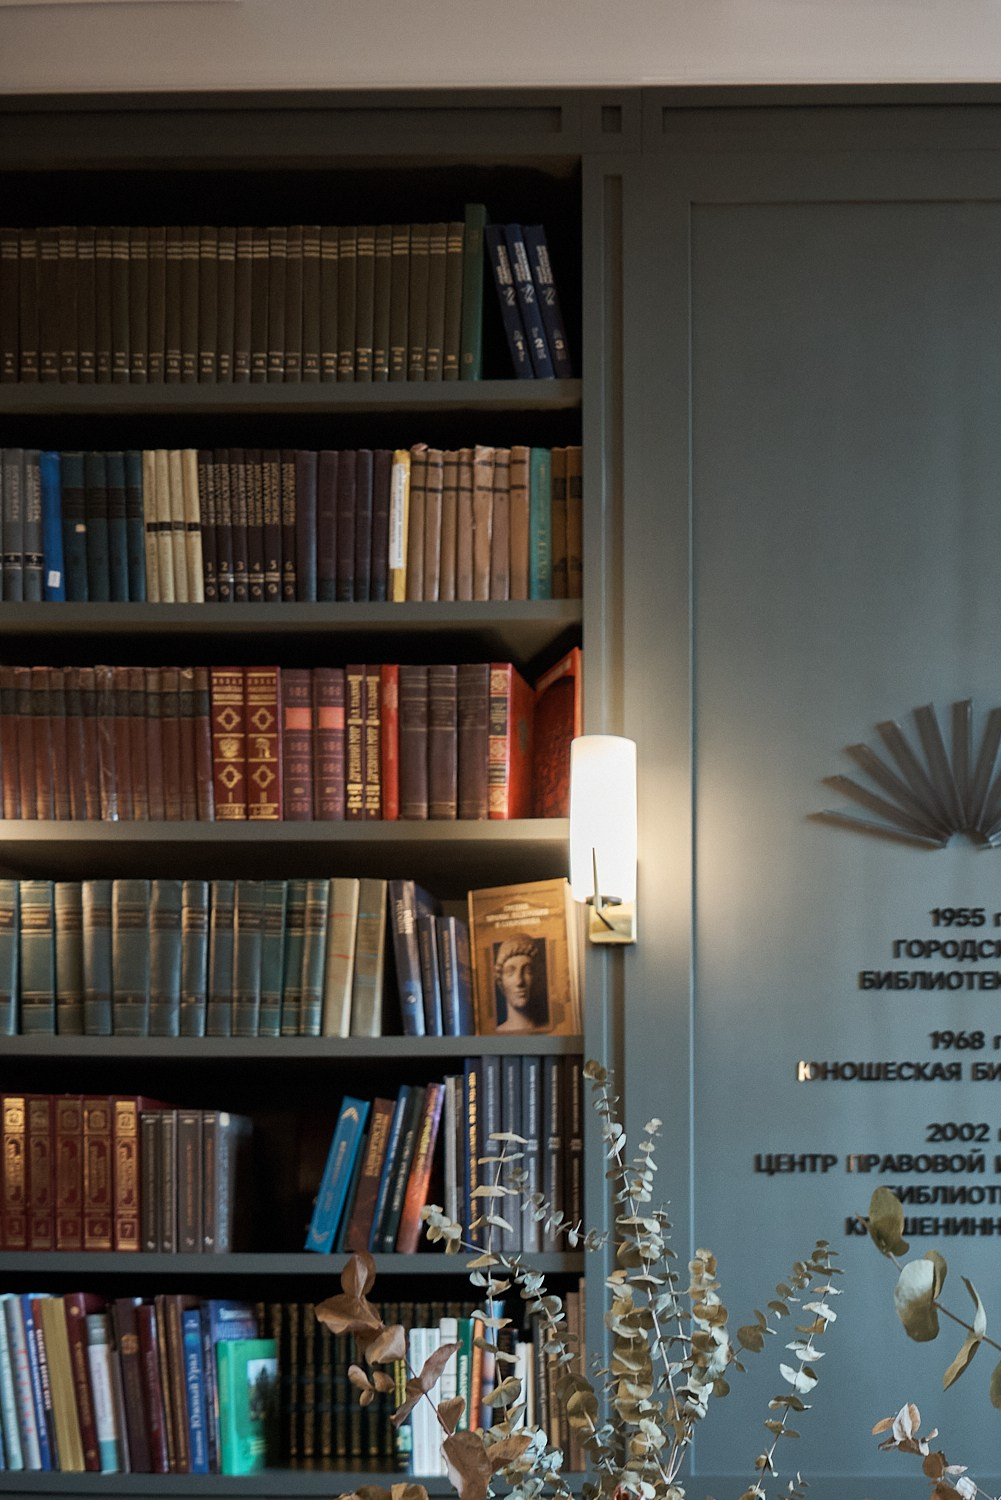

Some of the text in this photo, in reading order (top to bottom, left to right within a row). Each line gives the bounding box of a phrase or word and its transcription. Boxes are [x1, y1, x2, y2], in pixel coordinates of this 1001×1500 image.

[533, 337, 544, 349] 2
[554, 339, 564, 350] 3
[930, 908, 986, 928] 1955
[929, 1030, 985, 1050] 1968
[796, 1060, 962, 1083] ЮНОШЕСКАЯ
[926, 1122, 990, 1142] 2002
[754, 1153, 838, 1177] ЦЕНТР
[846, 1148, 986, 1174] ПРАВОВОЙ
